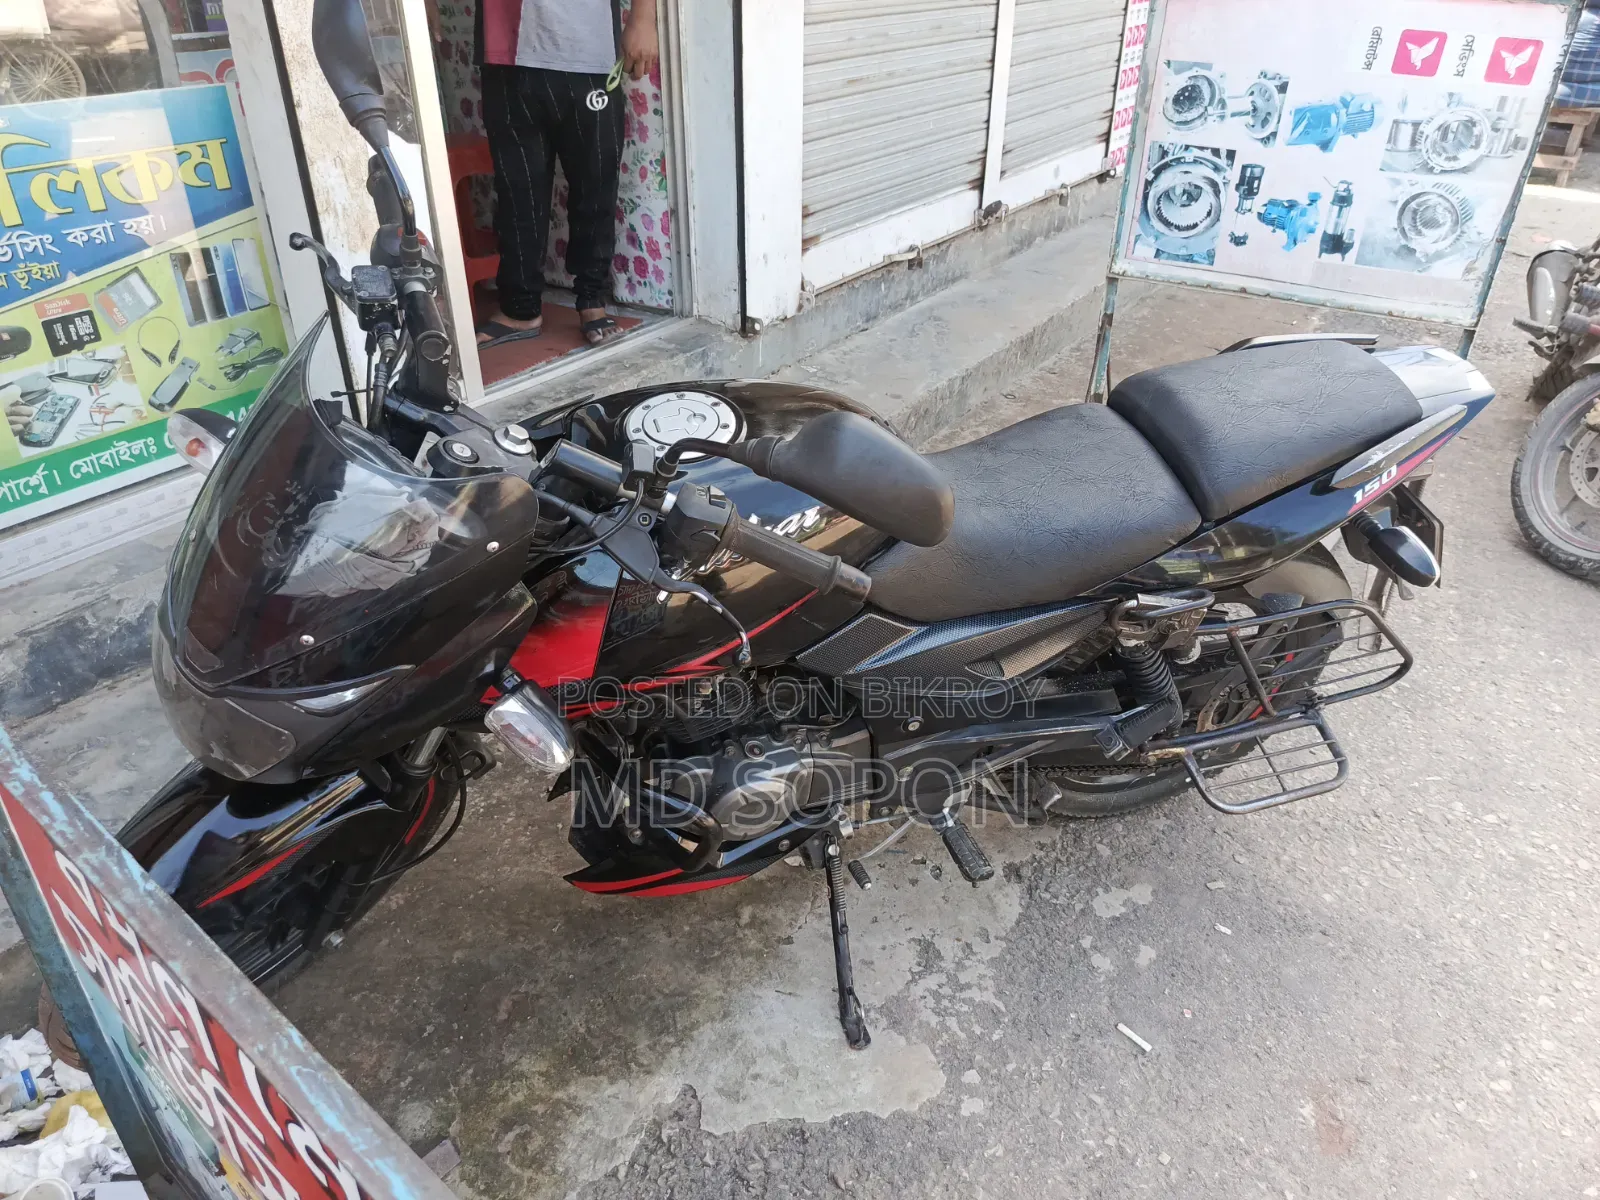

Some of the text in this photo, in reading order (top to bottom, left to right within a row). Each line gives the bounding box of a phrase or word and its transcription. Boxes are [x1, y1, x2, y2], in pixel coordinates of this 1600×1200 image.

[1453, 34, 1476, 78] সেভিংস
[61, 219, 115, 248] করা
[1353, 465, 1398, 504] 150
